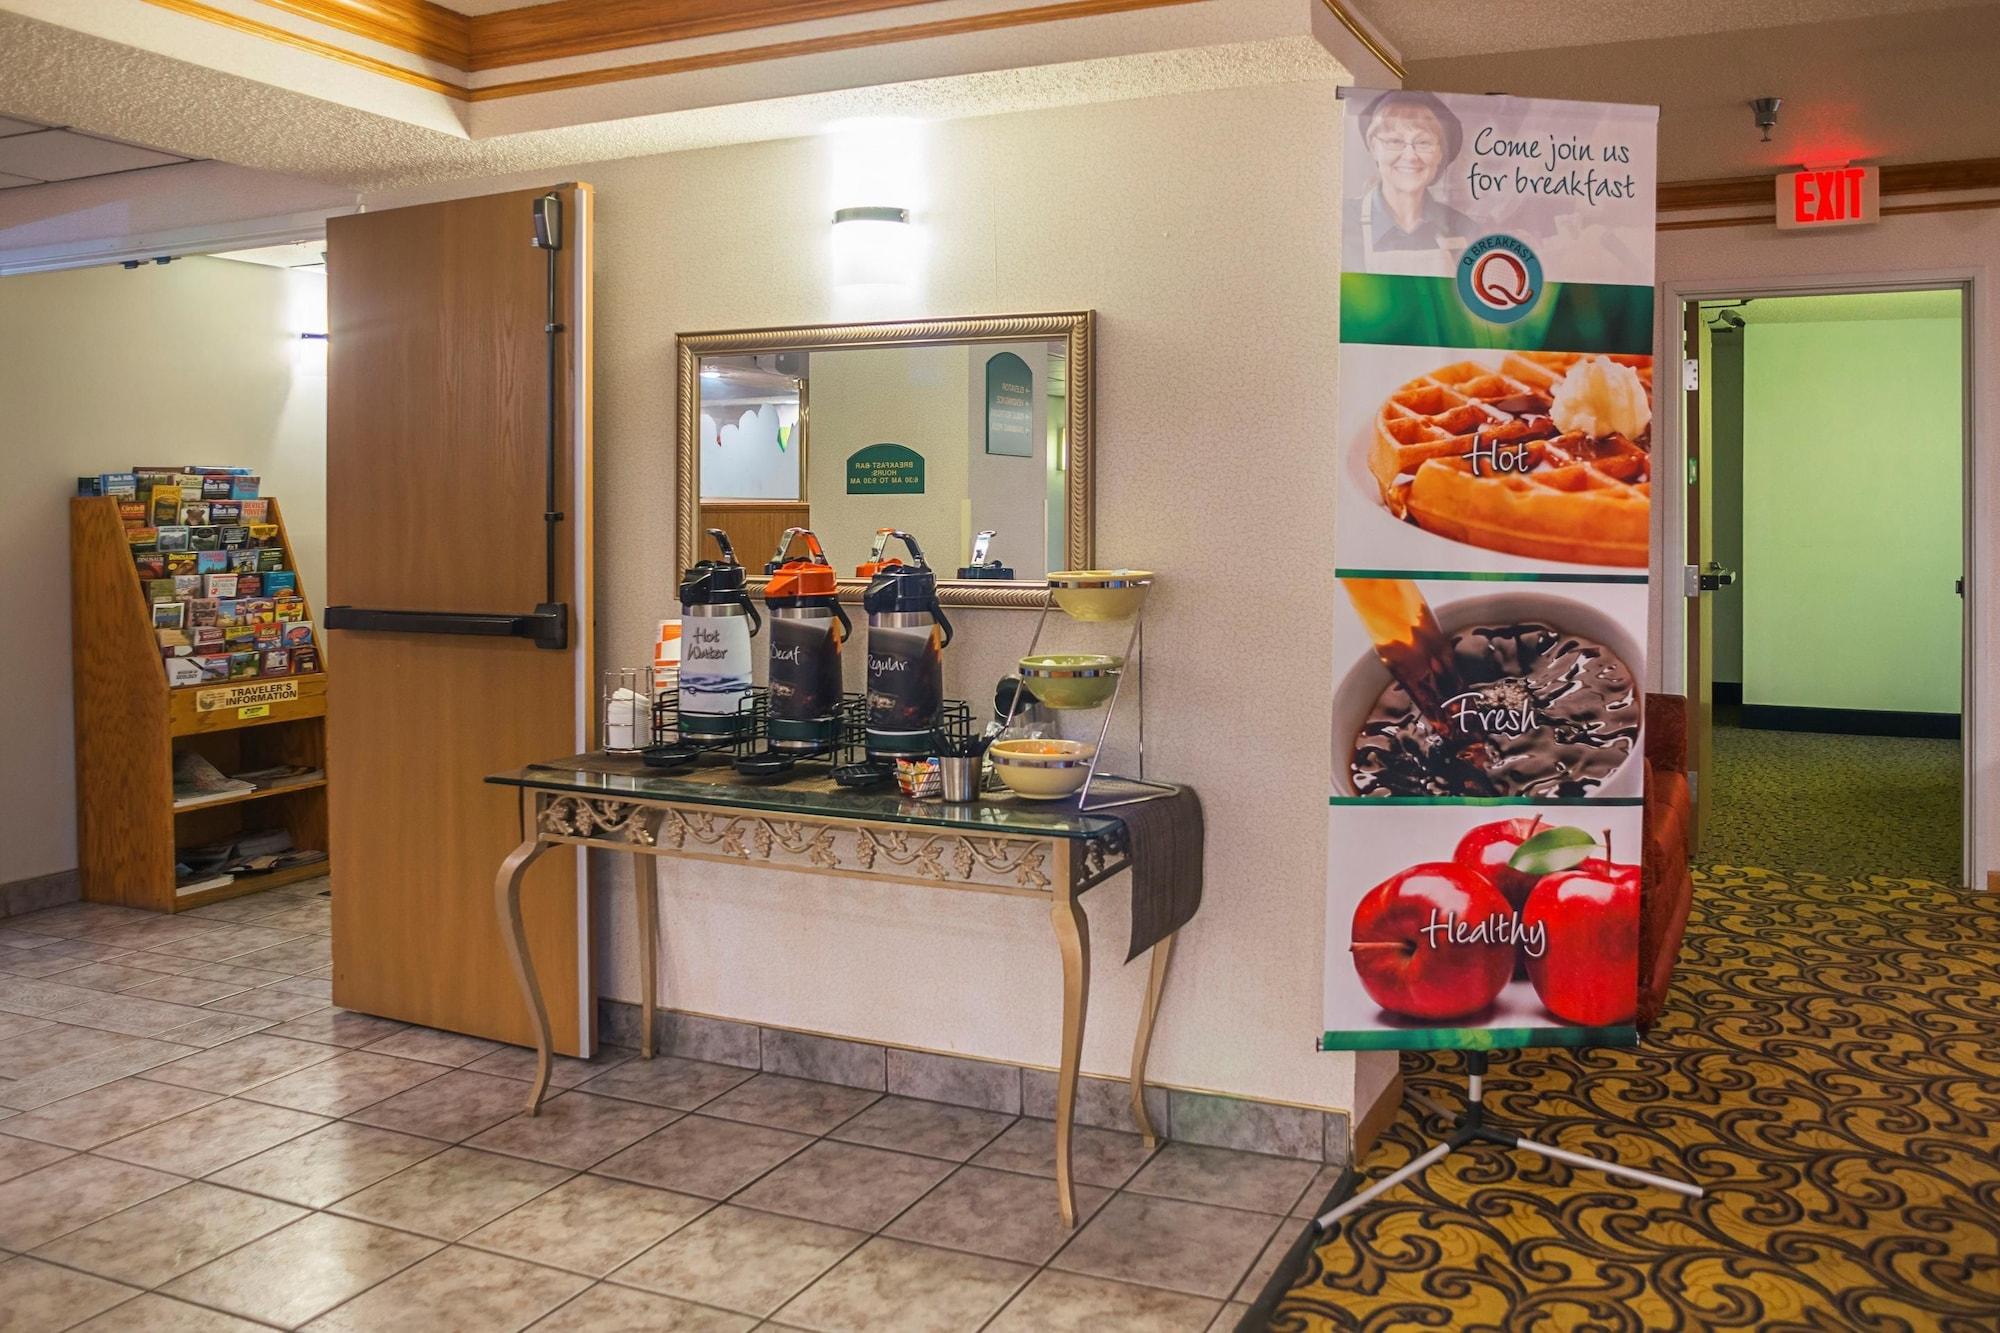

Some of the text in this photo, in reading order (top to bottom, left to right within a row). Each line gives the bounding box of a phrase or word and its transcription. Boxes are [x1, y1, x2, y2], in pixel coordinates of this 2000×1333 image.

[1474, 127, 1630, 172] Come join us
[1467, 162, 1635, 206] for breakfast
[1795, 168, 1866, 223] EXIT
[1463, 238, 1535, 266] Q BREAKFAST
[1473, 252, 1535, 306] Q
[1462, 433, 1529, 476] Hot
[687, 643, 729, 661] Water
[692, 627, 721, 644] Hot
[770, 641, 801, 665] Decaf
[225, 690, 297, 706] INFORMATION
[230, 682, 293, 698] TRAVELER'S
[1440, 691, 1541, 733] Fresh
[1420, 907, 1546, 958] Healthy
